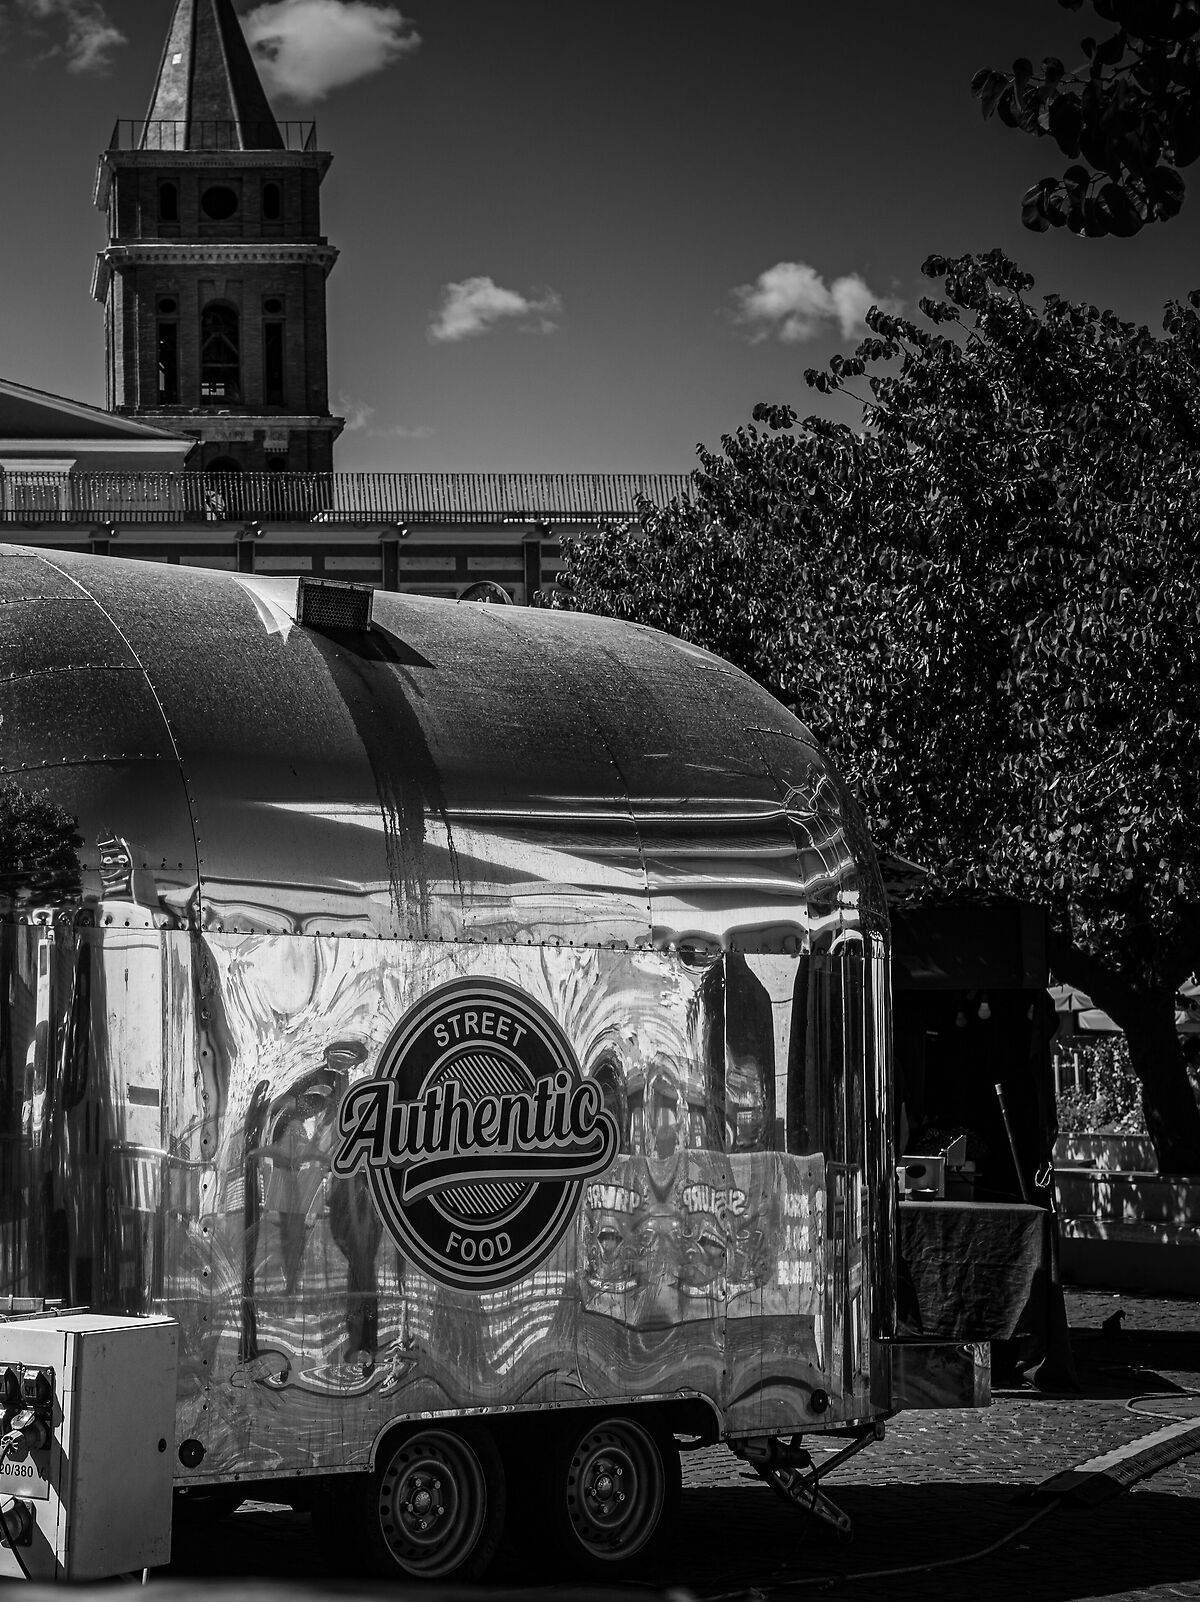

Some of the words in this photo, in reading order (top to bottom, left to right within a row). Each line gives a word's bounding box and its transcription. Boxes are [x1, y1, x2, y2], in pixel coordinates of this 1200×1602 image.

[432, 1010, 528, 1048] STREET
[335, 1070, 607, 1168] Authentic
[445, 1231, 512, 1262] FOOD
